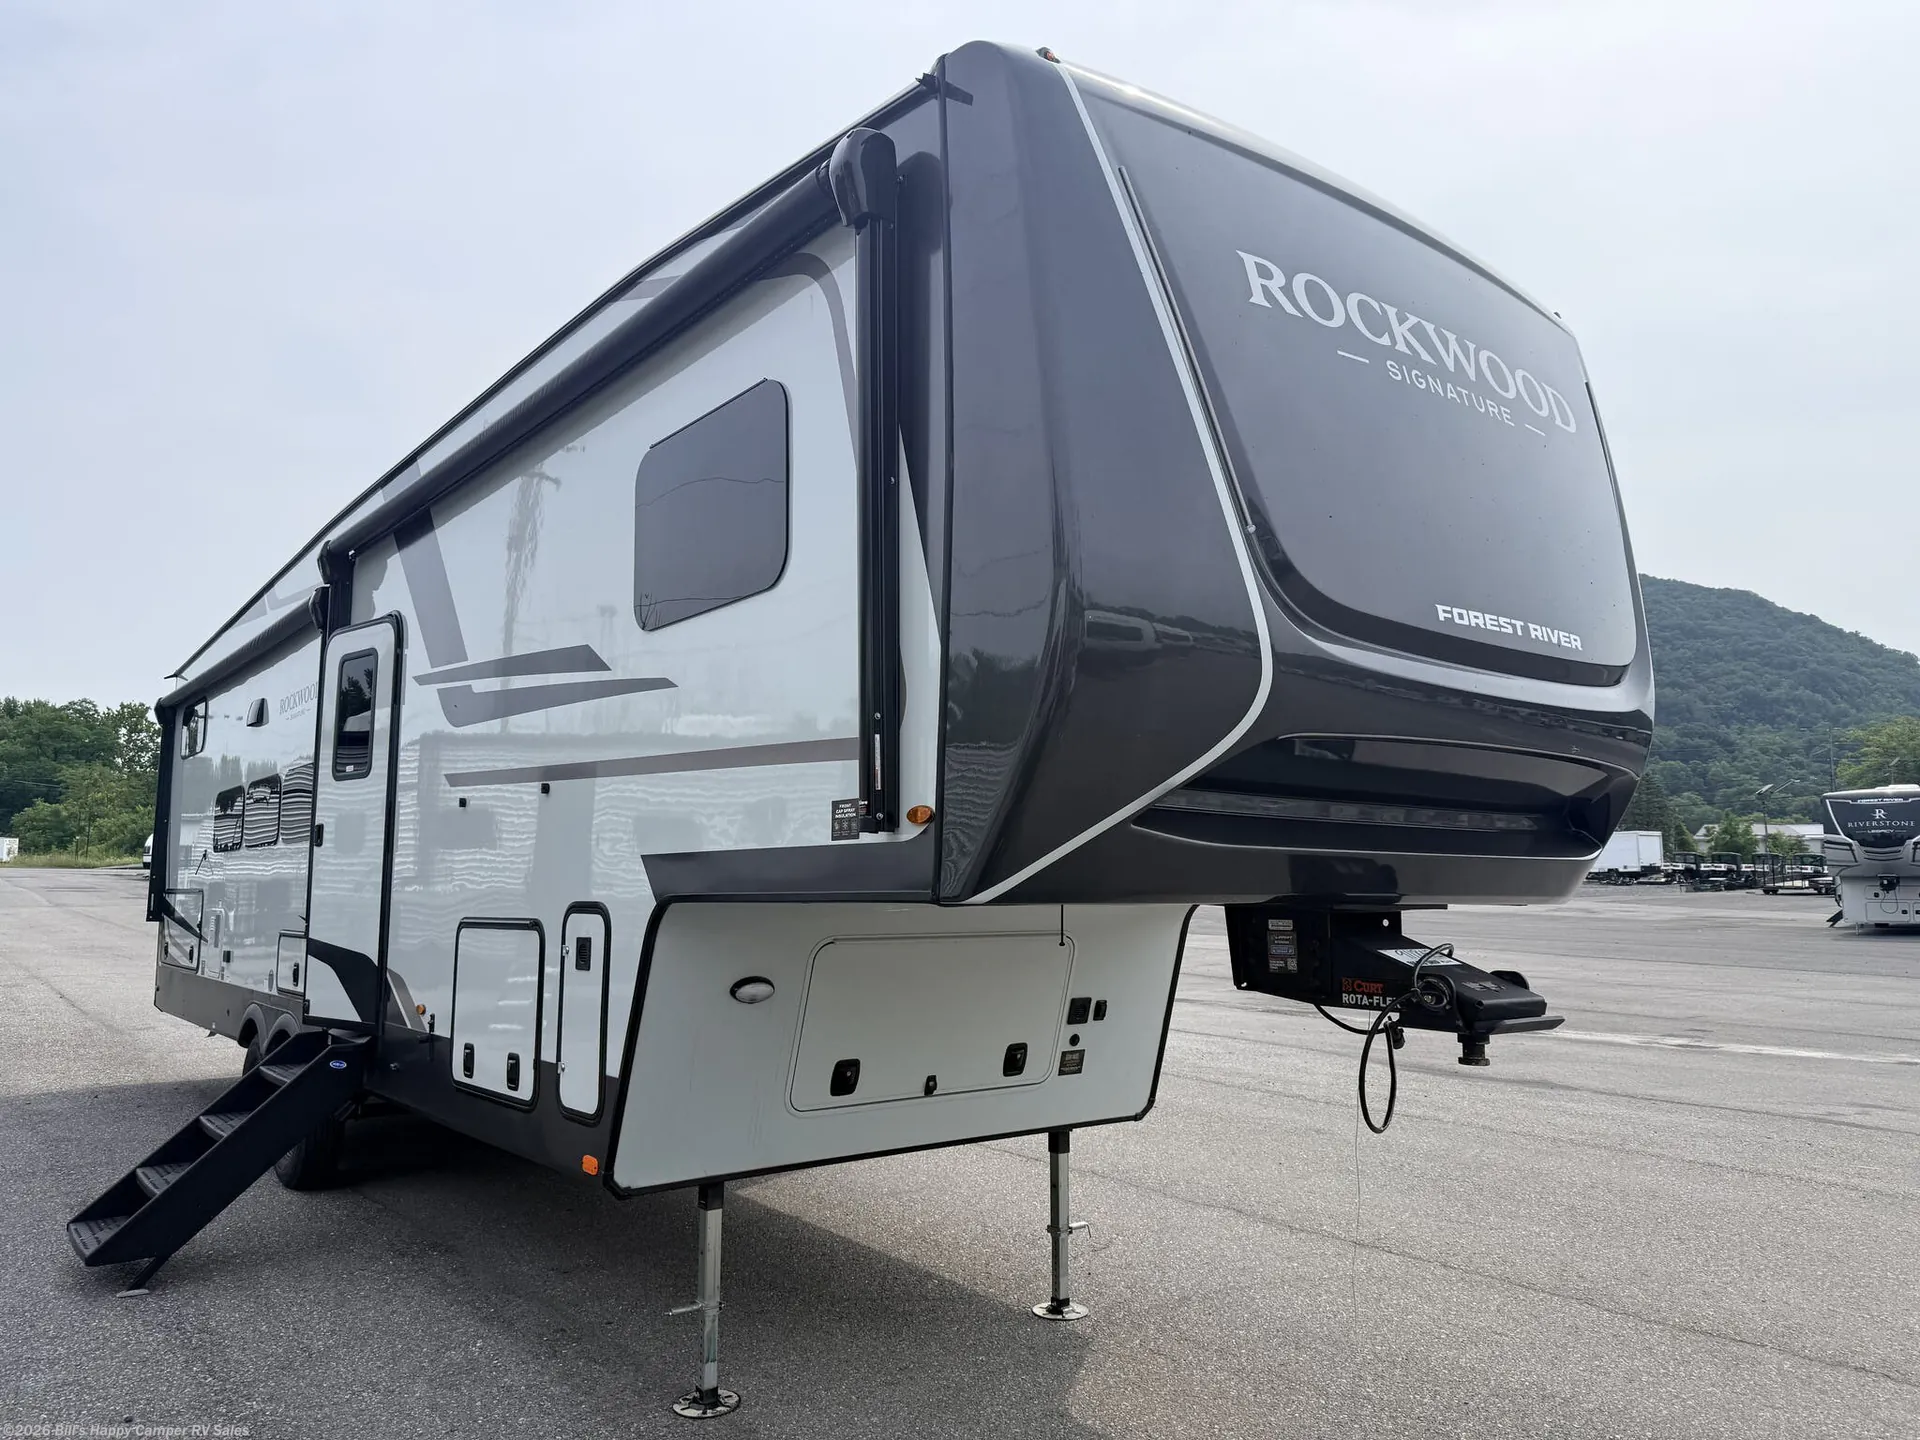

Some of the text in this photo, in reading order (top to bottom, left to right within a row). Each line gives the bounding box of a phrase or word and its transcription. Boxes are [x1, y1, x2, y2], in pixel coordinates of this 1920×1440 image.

[1236, 250, 1577, 434] ROCKWOOD
[1386, 360, 1514, 426] SIGNATURE
[1435, 604, 1583, 650] FOREST RIVER
[279, 681, 318, 715] ROCKWOO
[1342, 993, 1401, 1008] ROTA-FLE
[1354, 980, 1383, 993] CURT
